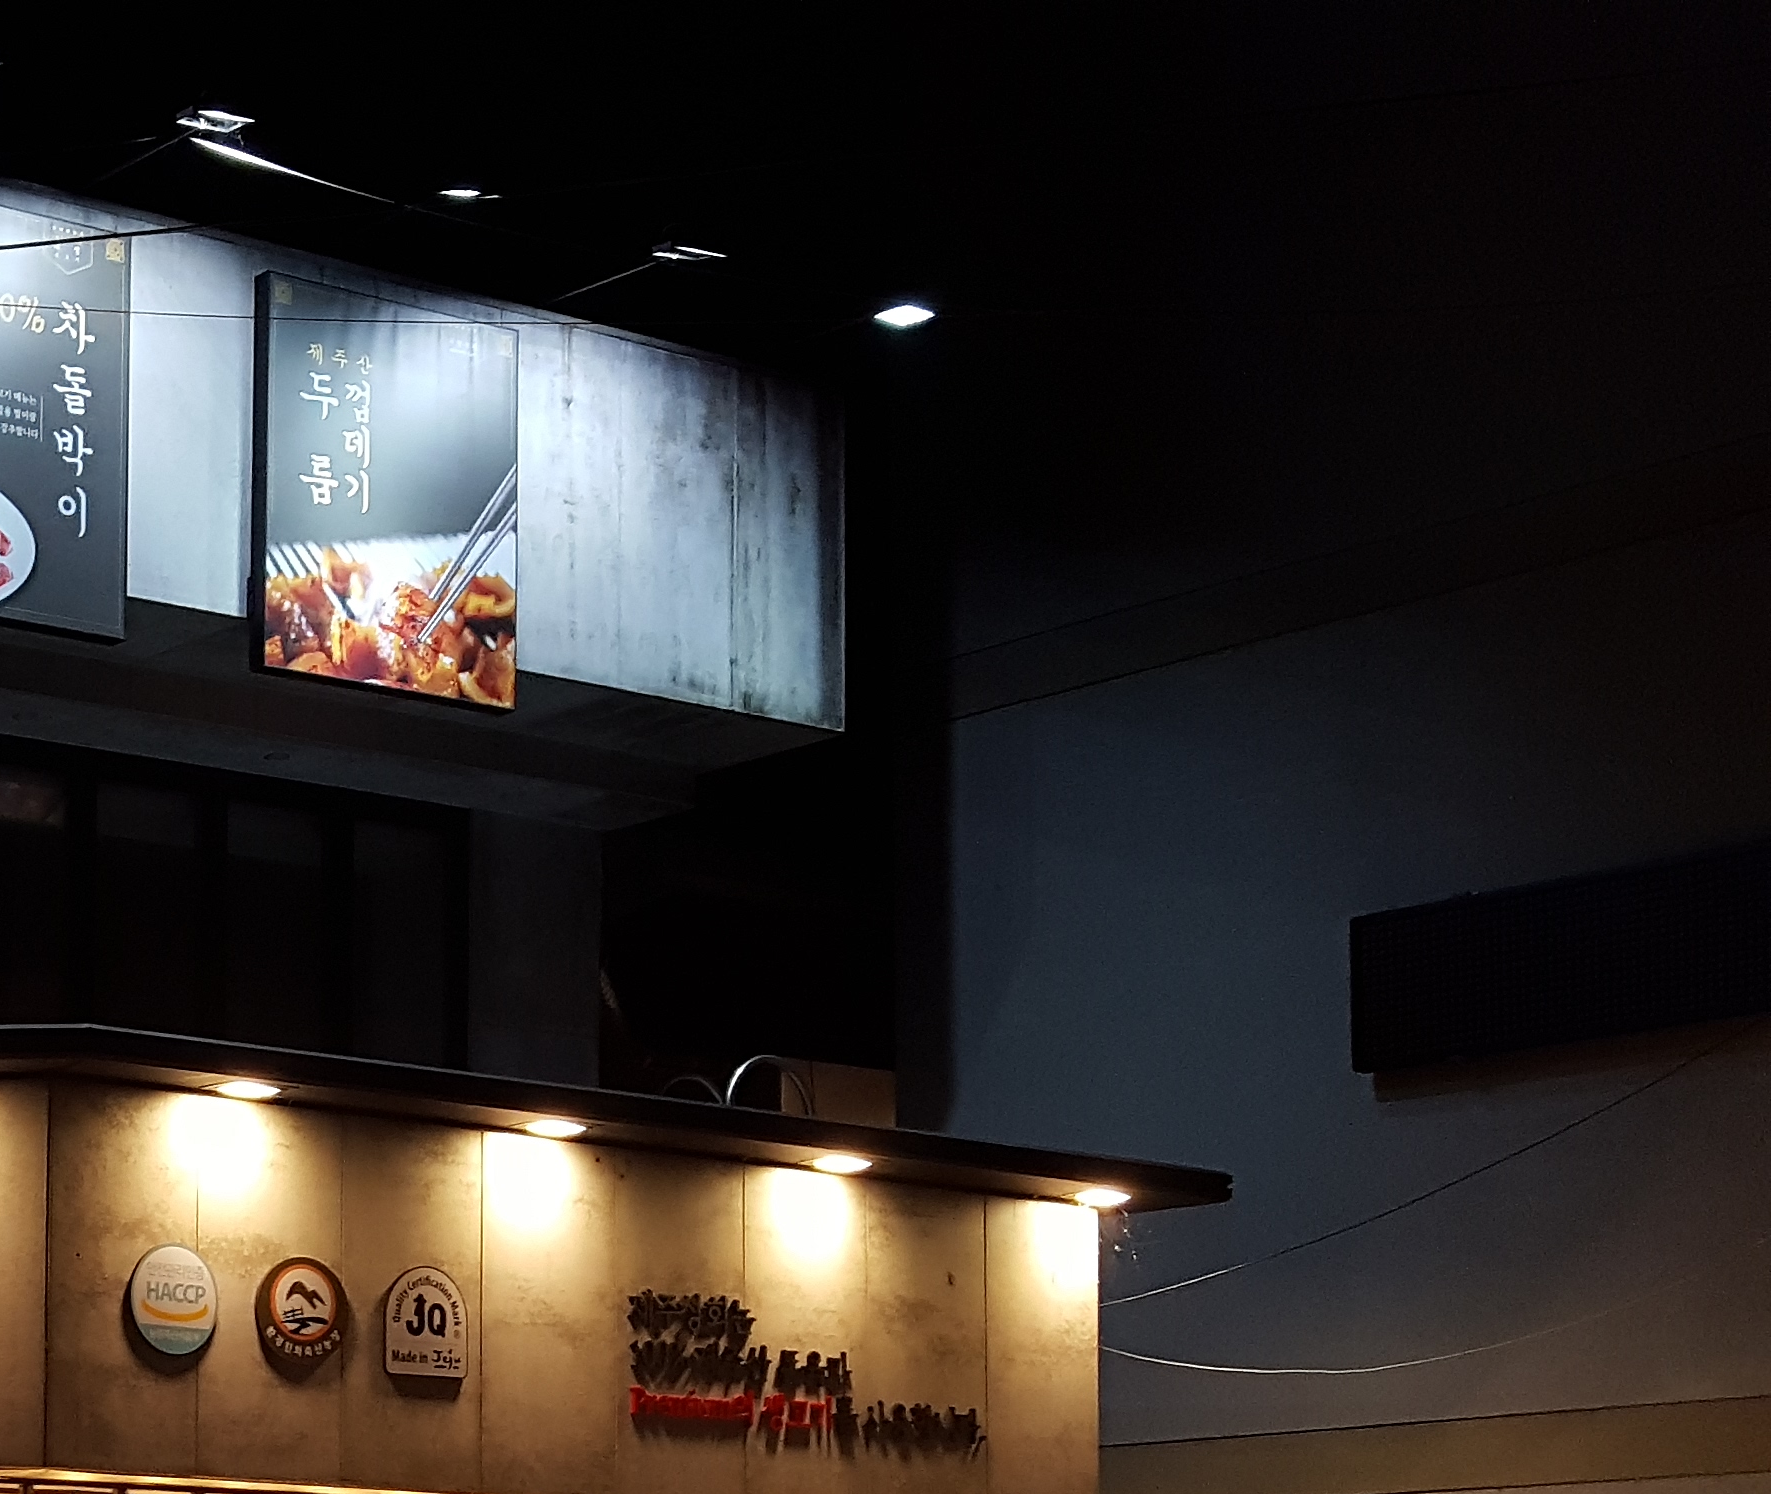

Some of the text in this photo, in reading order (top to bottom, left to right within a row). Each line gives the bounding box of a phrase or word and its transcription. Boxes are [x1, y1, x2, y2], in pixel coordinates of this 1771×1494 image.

[306, 343, 374, 376] 제주산
[52, 300, 96, 539] 차돌박이
[343, 379, 373, 515] 껍데기
[146, 1281, 207, 1305] HACCP
[391, 1349, 418, 1363] Made
[431, 1348, 463, 1370] Jeju
